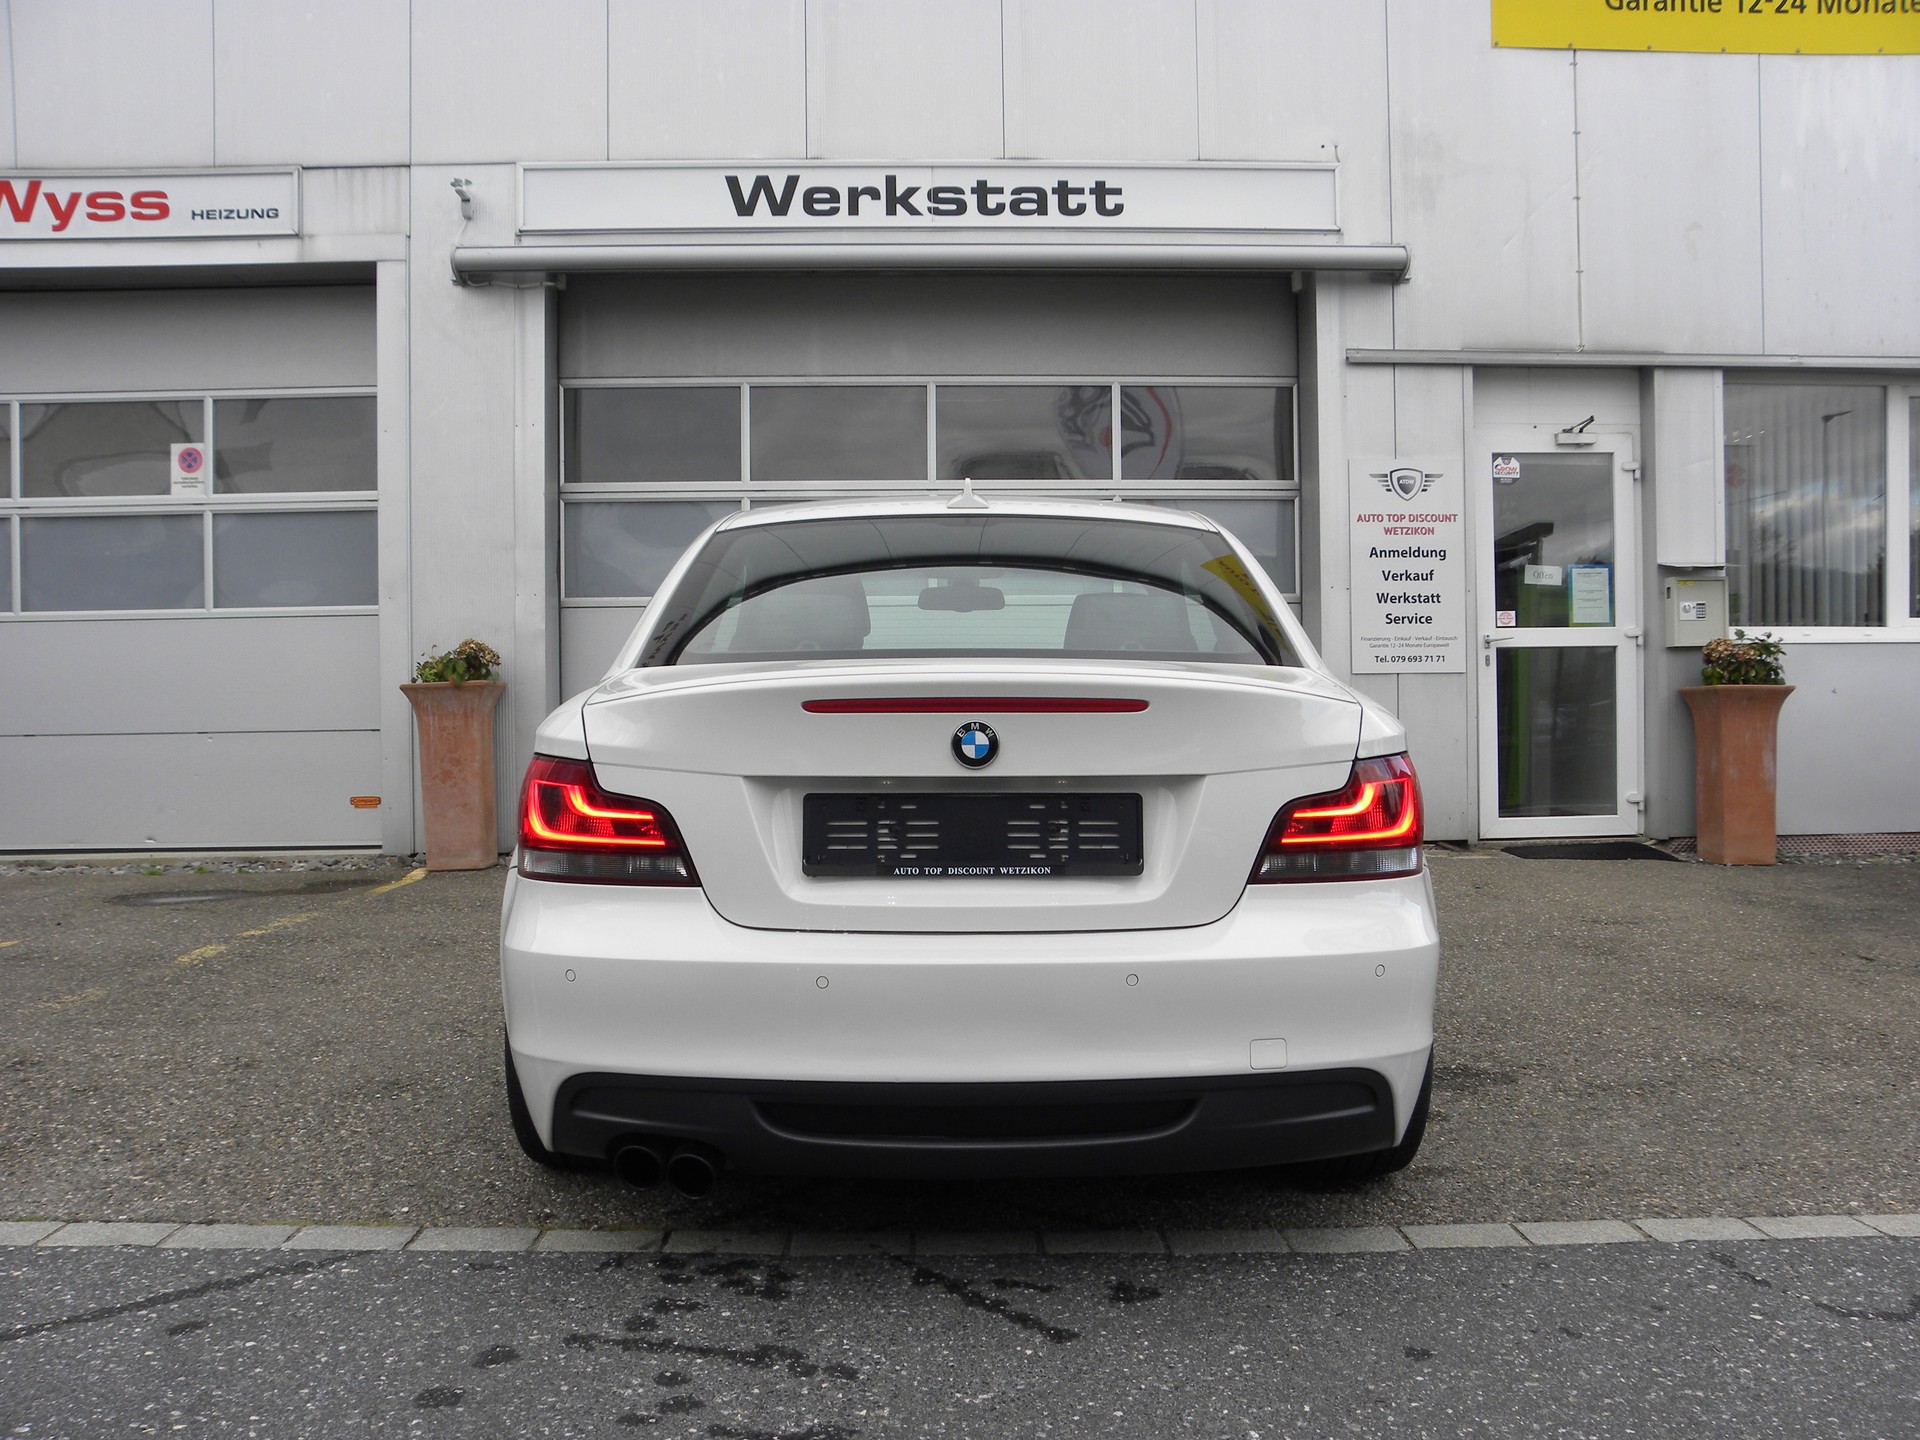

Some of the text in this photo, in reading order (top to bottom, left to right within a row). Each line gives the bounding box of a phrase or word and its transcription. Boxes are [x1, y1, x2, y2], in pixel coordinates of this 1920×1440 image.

[724, 174, 1125, 217] Werkstatt
[191, 208, 279, 220] HEIZUNG
[1357, 514, 1458, 522] AUTO TOP DISCOUNT
[1384, 527, 1435, 535] WETZIKON
[1369, 546, 1447, 561] Anmeldung
[1382, 569, 1435, 581] Verkauf
[1376, 592, 1441, 604] Werkstatt
[1385, 612, 1433, 624] Service
[1374, 655, 1389, 663] Tel.
[957, 723, 994, 737] BMW
[893, 866, 1052, 875] AUTO TOP DISCOUNT WETZIKON
